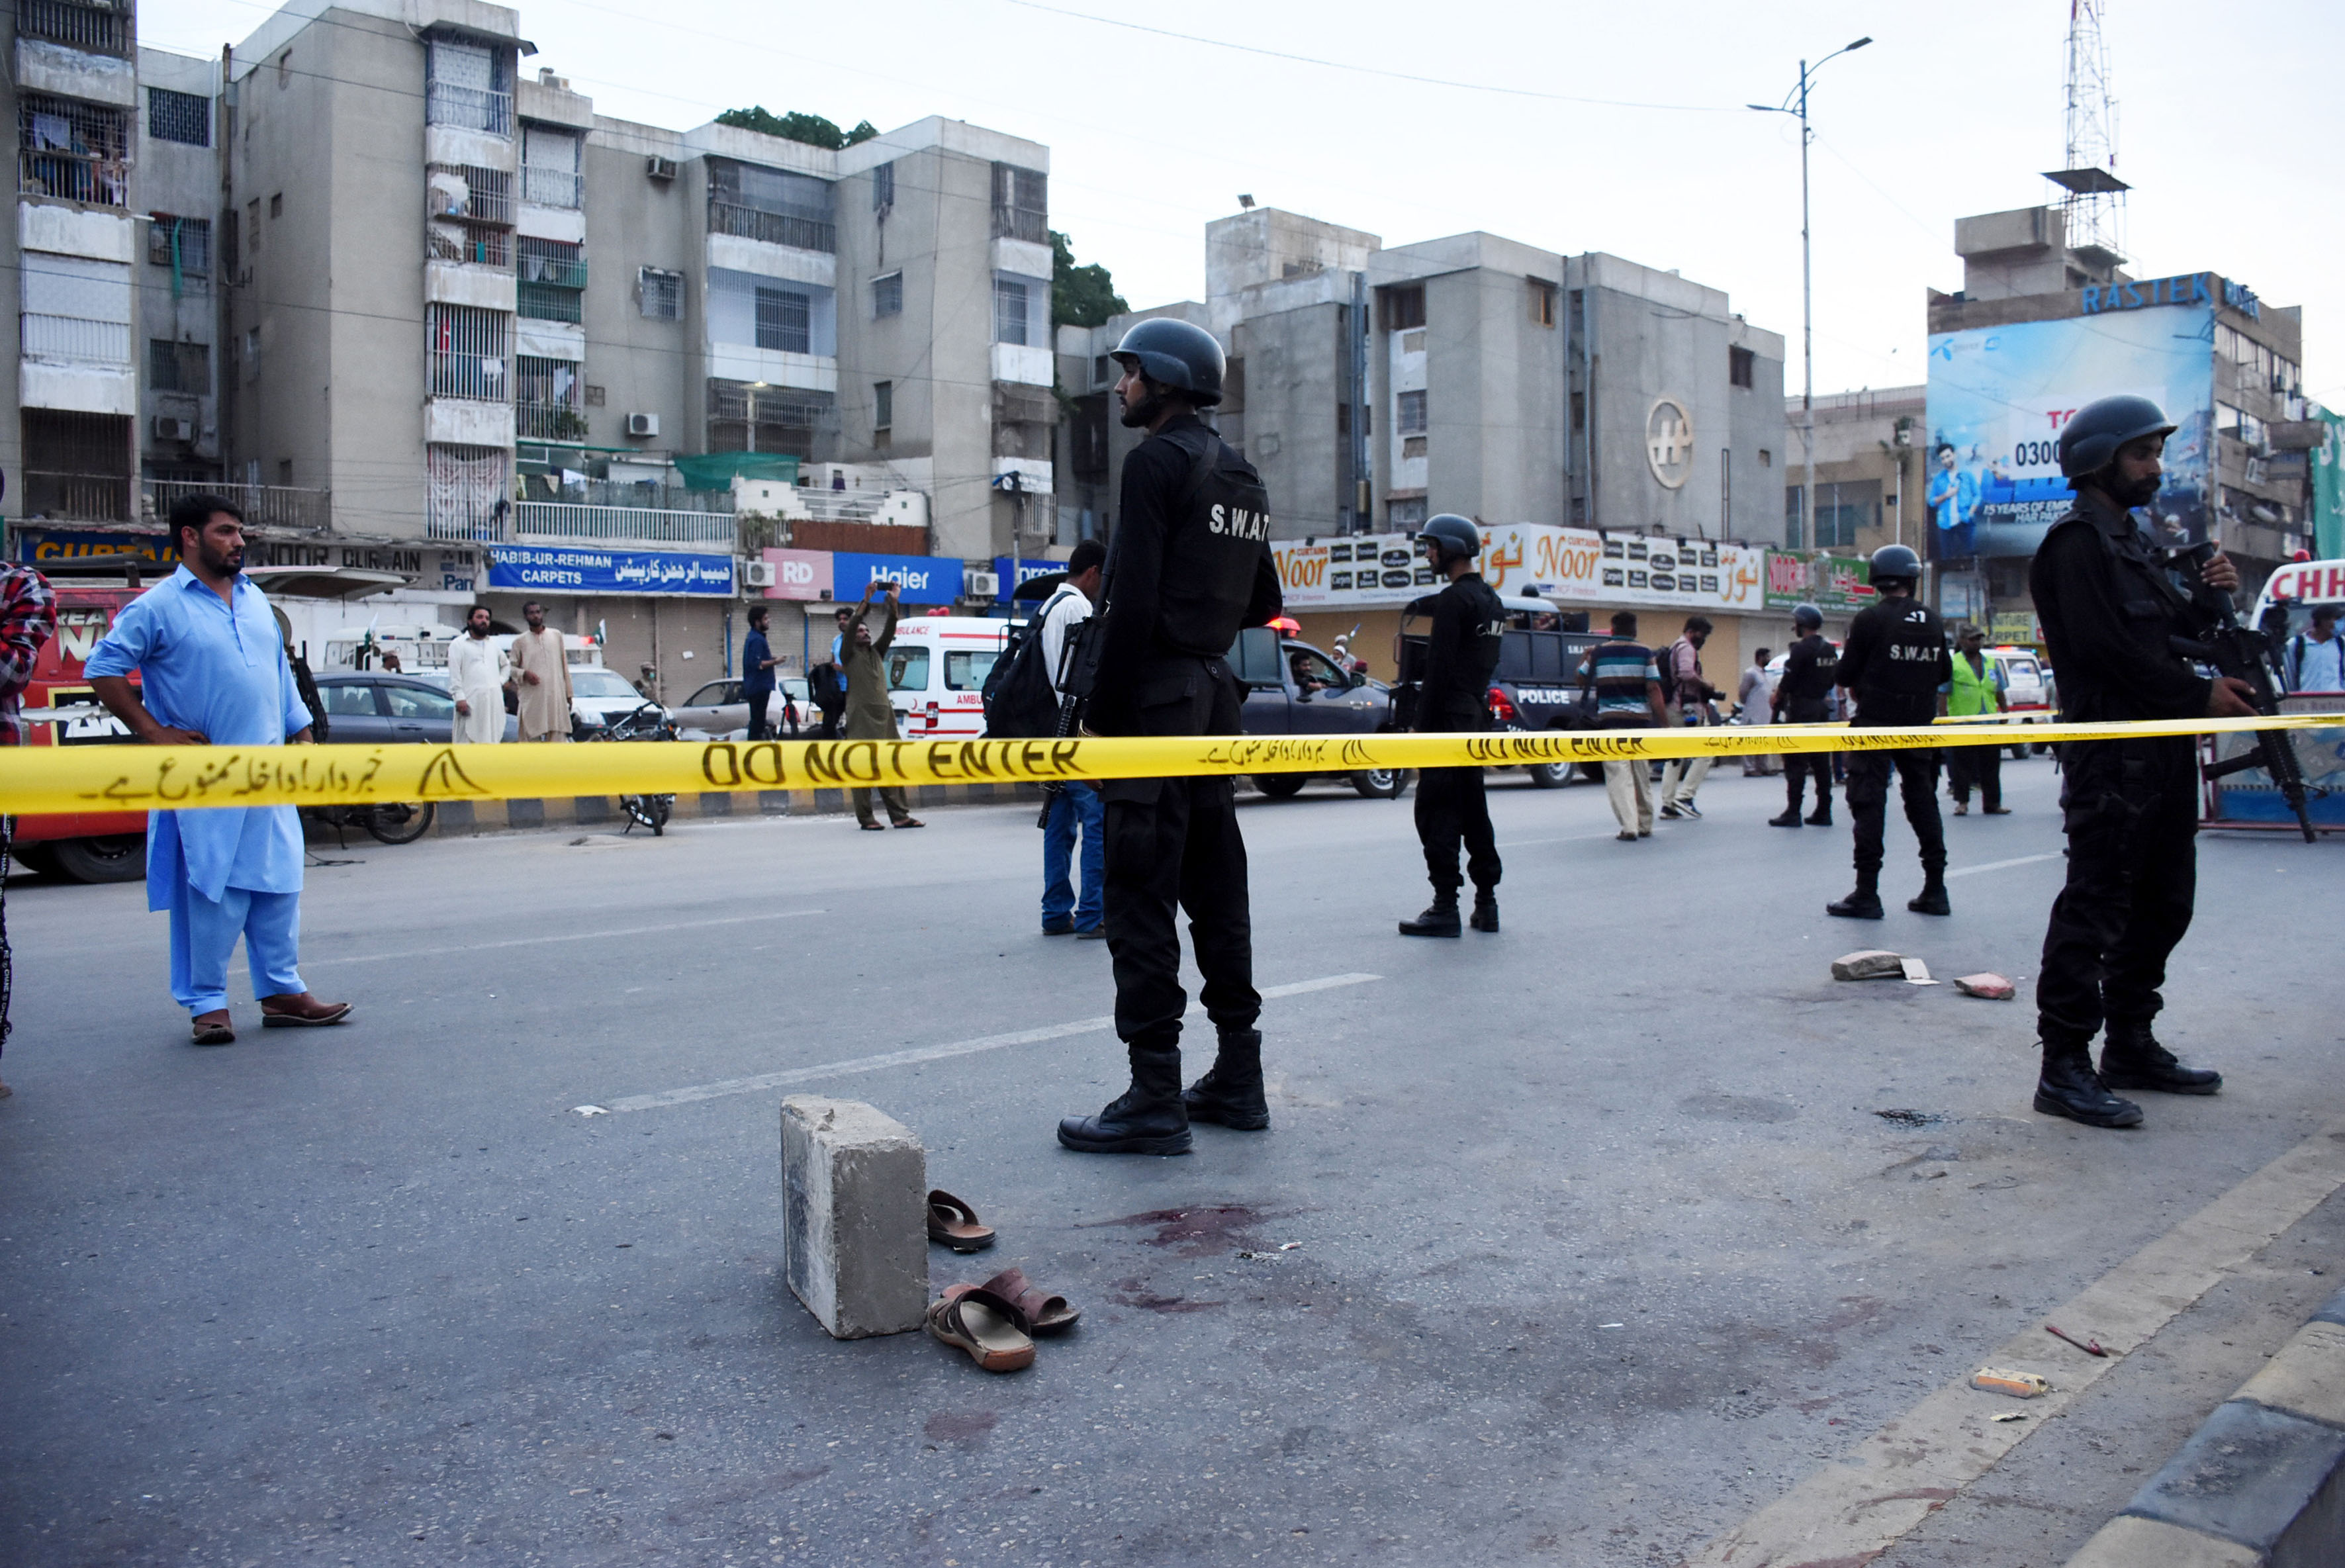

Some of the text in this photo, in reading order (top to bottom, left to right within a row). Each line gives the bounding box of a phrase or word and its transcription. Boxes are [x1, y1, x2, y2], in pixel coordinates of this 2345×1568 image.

[2082, 271, 2213, 314] RASTEK
[1996, 502, 2029, 515] YEARS
[2031, 500, 2045, 514] OF
[1209, 504, 1269, 541] S.W.A.T
[1297, 547, 1328, 556] CURTAINS
[1567, 535, 1600, 549] CURTAINS
[490, 551, 612, 568] HABIB-UR-REHMAN
[1534, 534, 1600, 580] Noor
[522, 569, 582, 584] CARPETS
[782, 560, 813, 584] RD
[870, 565, 929, 590] Haier
[1272, 548, 1328, 589] Noor
[1890, 643, 1941, 662] S.W.A.T
[1517, 689, 1571, 705] POLICE
[702, 740, 1089, 786] DO NOT ENTER
